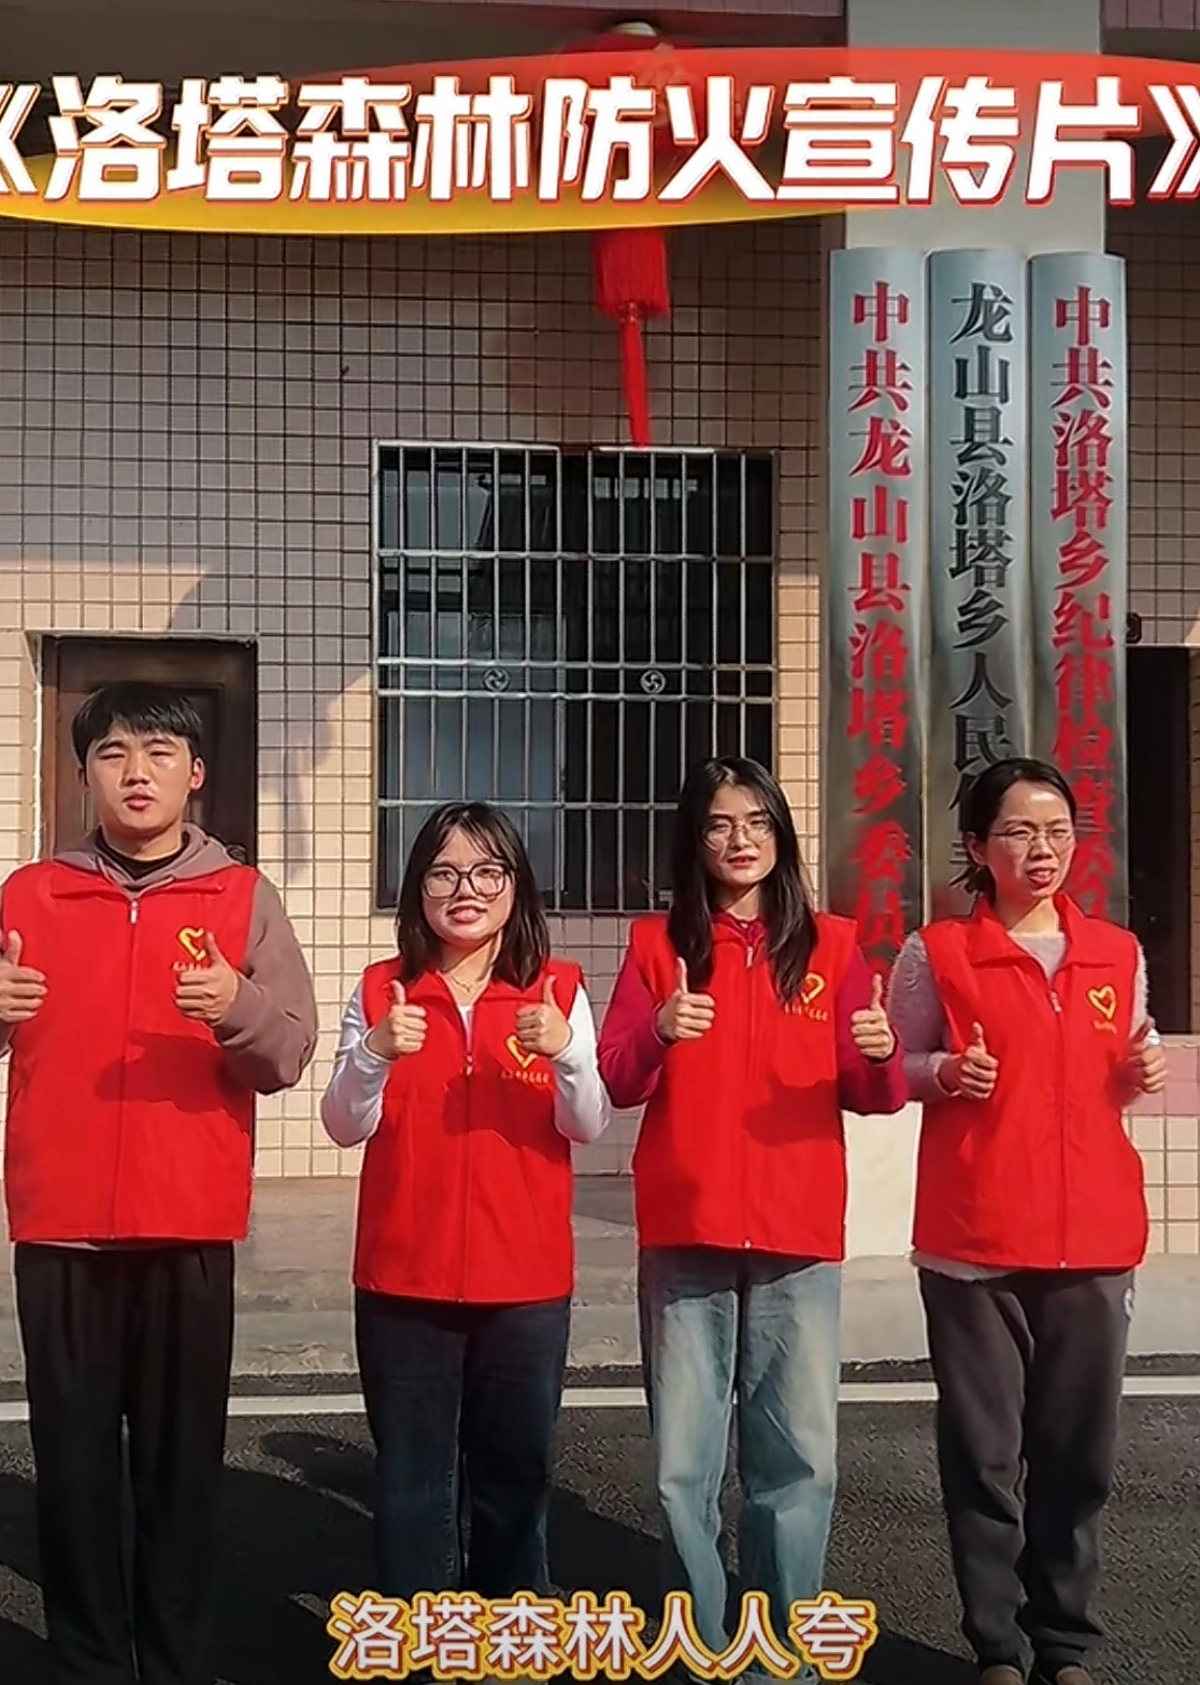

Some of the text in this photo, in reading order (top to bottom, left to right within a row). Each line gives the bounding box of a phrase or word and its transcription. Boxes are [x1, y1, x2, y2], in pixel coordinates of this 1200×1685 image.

[848, 280, 914, 974] 中共龙山县洛塔乡委员
[948, 280, 1014, 890] 龙山县洛塔乡人民
